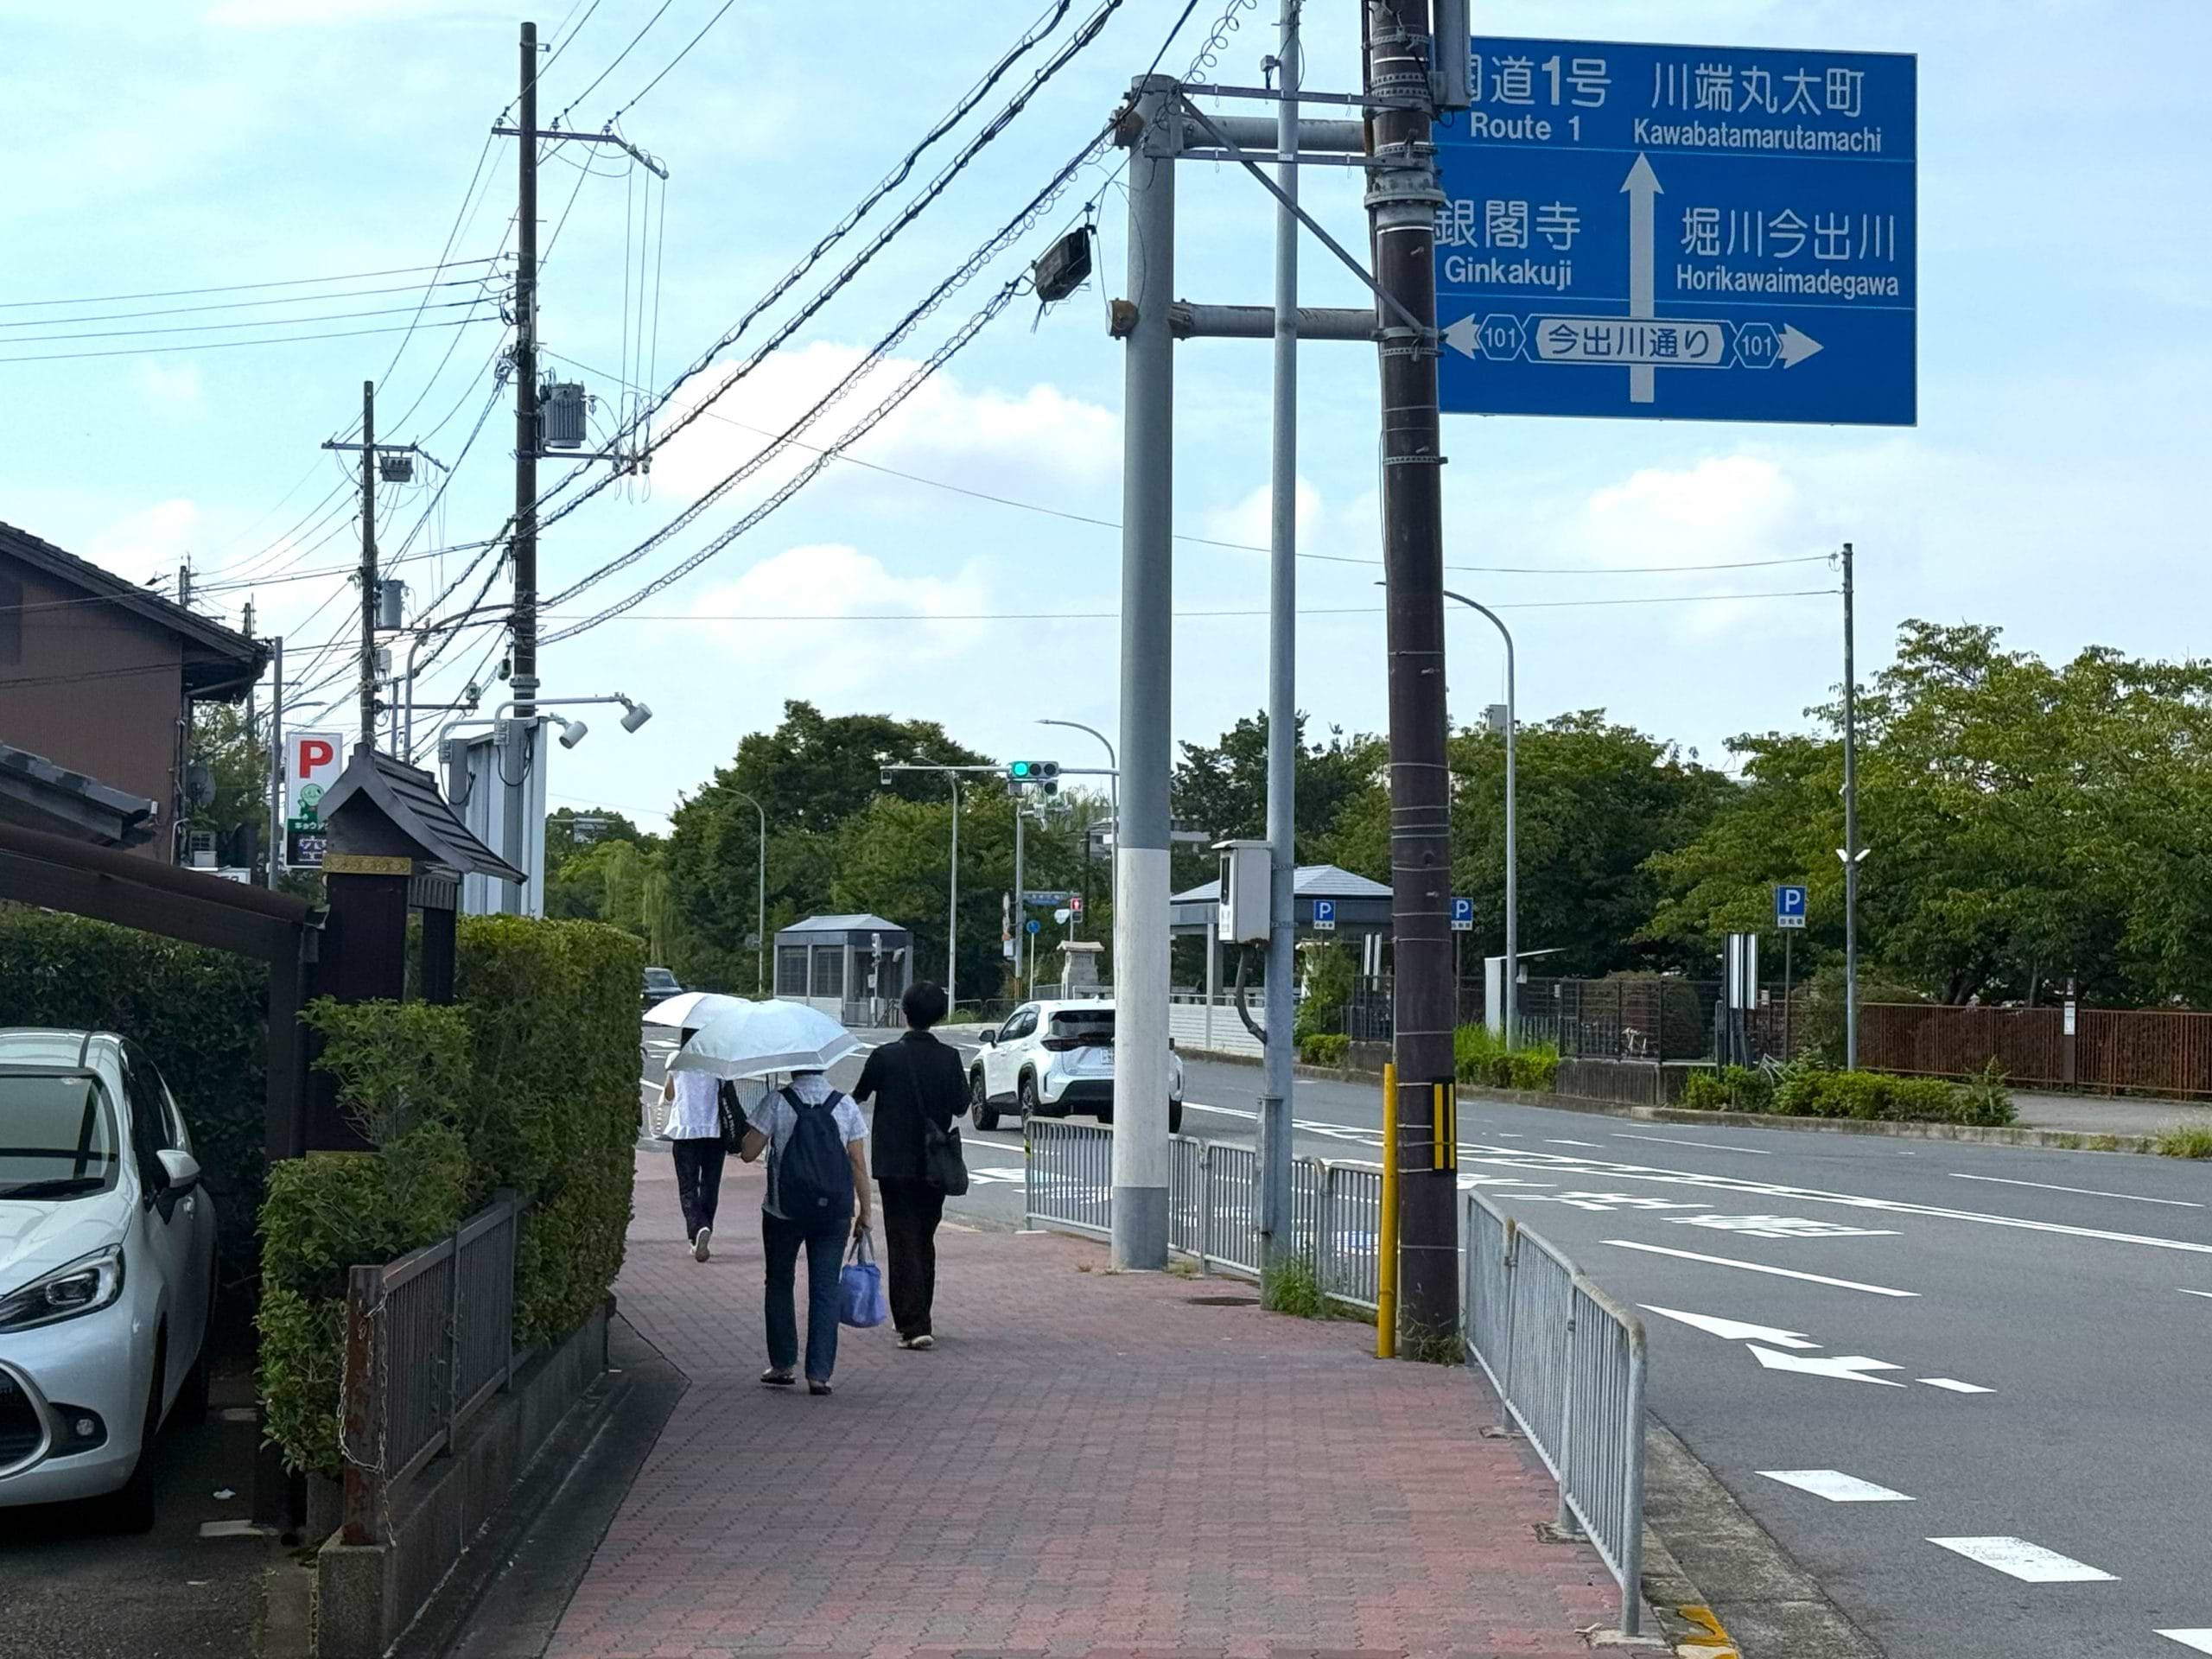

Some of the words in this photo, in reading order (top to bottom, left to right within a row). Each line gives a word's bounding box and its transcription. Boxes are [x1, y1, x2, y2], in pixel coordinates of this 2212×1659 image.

[1471, 54, 1612, 108] 道1号
[1651, 61, 1866, 118] 川端丸太町
[1471, 111, 1552, 141] Route
[1568, 115, 1580, 142] 1
[1634, 118, 1882, 153] Kawabatamarutamachi
[1434, 199, 1581, 251] 銀閣寺
[1680, 207, 1895, 263] 堀川今出川
[1444, 255, 1573, 291] Ginkakuji
[1676, 263, 1900, 301] Horikawaimadegawa
[1484, 327, 1516, 348] 101
[1548, 323, 1710, 359] 今出川通り
[1741, 336, 1771, 357] 101
[299, 740, 334, 779] P
[1319, 902, 1332, 919] P
[1456, 899, 1469, 918] P
[1785, 889, 1801, 913] P
